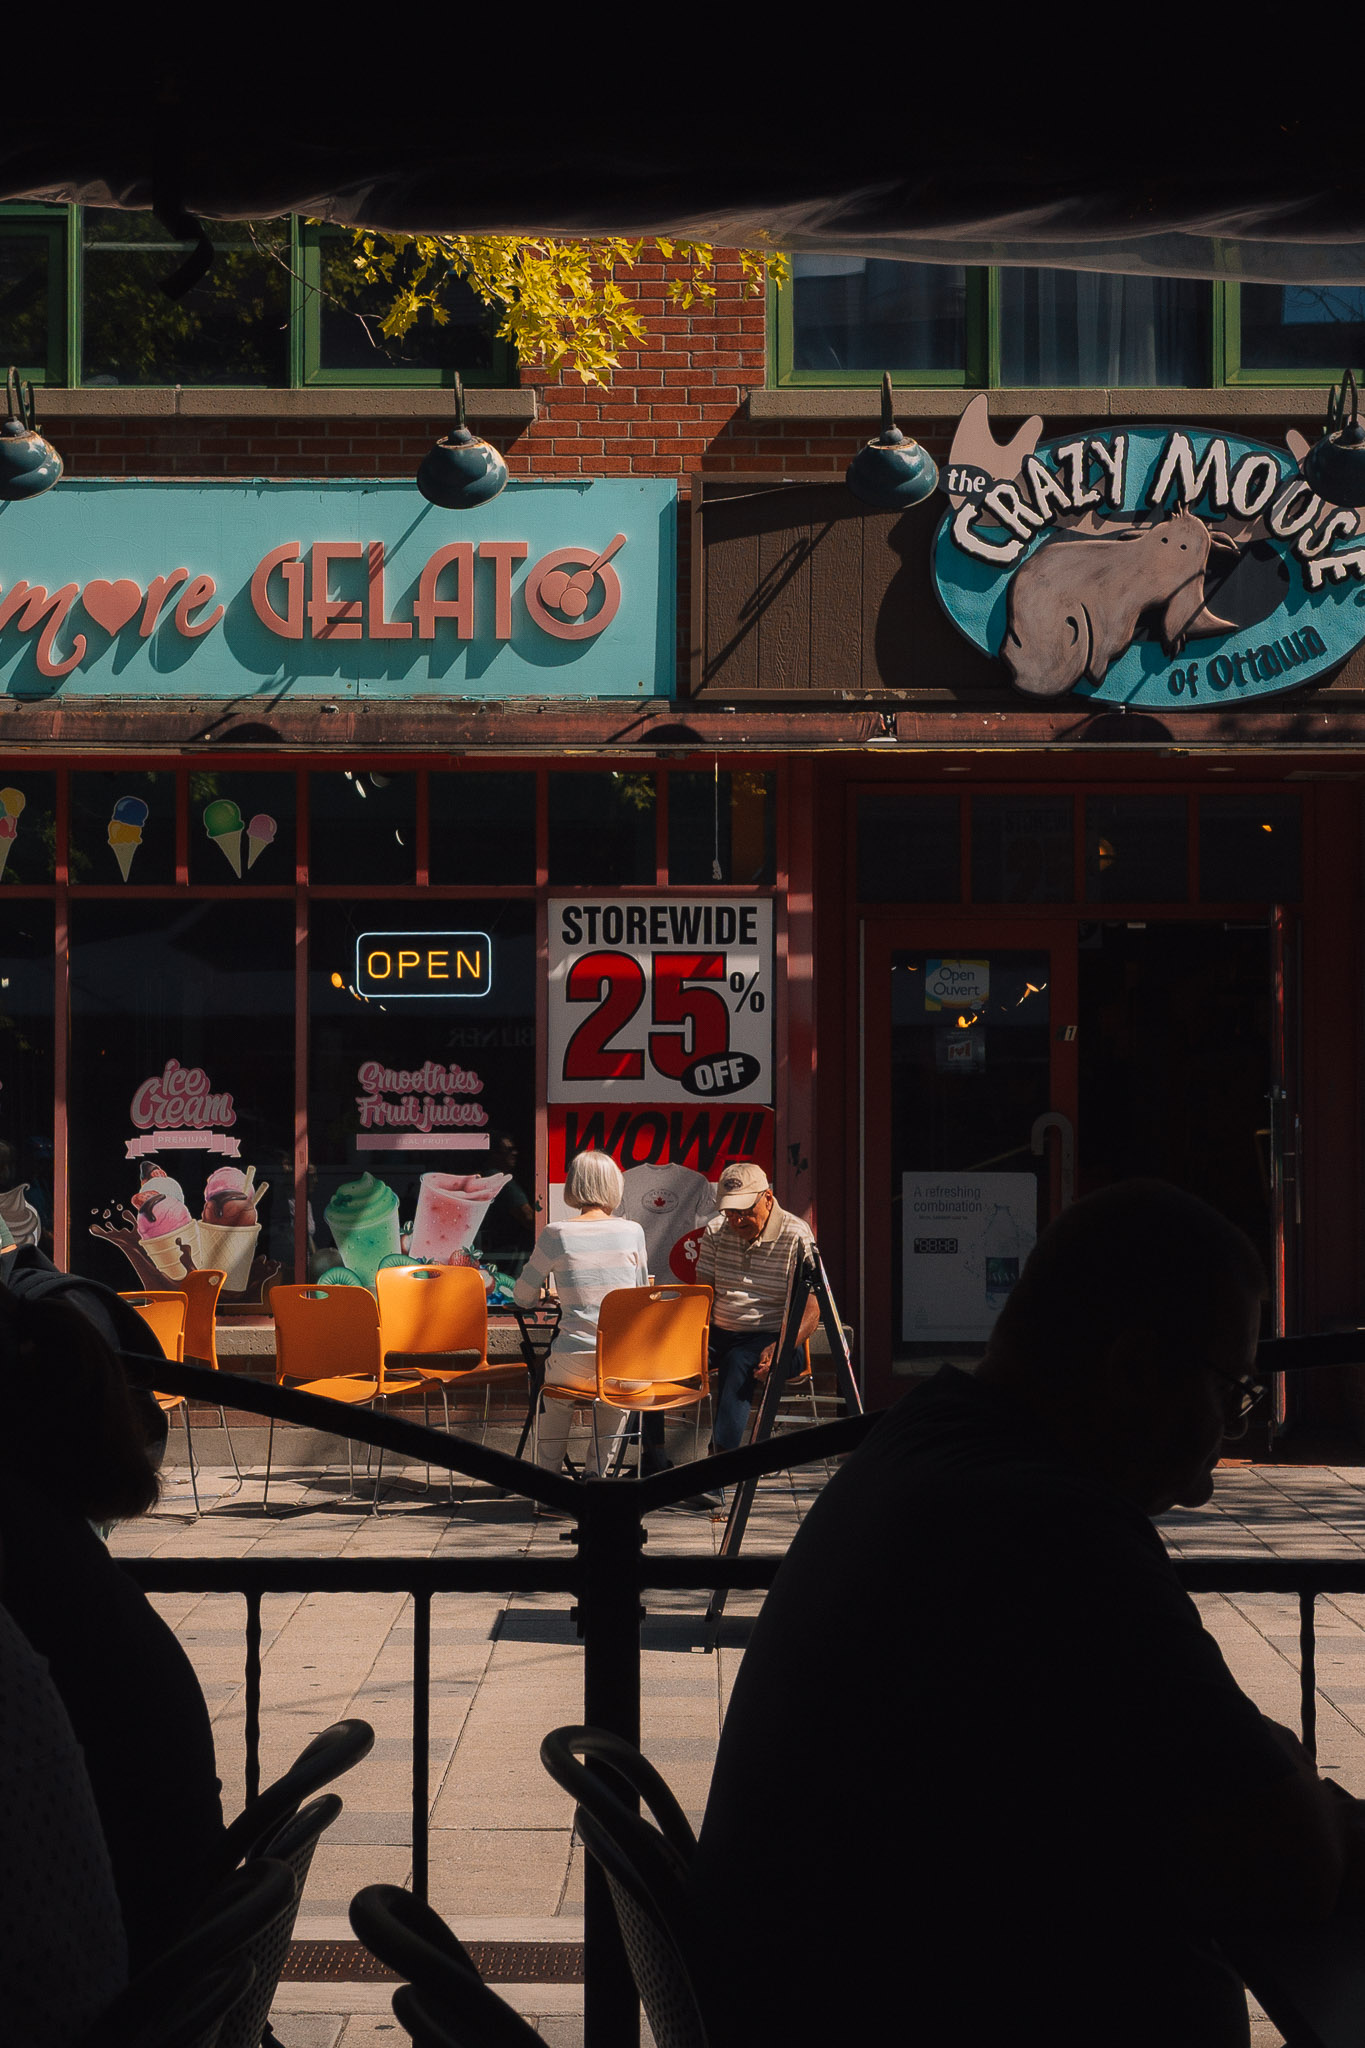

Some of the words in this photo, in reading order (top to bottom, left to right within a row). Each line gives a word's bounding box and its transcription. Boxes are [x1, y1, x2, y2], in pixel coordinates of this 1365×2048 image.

[947, 468, 987, 493] the
[953, 434, 1128, 565] CRAZY
[1151, 433, 1365, 588] MOOSE
[250, 532, 627, 641] GELATO
[1167, 663, 1198, 697] of
[1206, 625, 1328, 690] Ottawa
[562, 905, 758, 945] STOREWIDE
[367, 950, 482, 979] OPEN
[939, 967, 975, 984] Open
[933, 982, 980, 995] Ouvert
[562, 949, 765, 1081] 25%
[694, 1057, 745, 1091] OFF
[357, 1061, 483, 1095] Smoothies
[131, 1079, 236, 1128] Cream
[356, 1097, 418, 1128] Fruit
[413, 1097, 488, 1132] juices
[157, 1135, 208, 1144] PREMIUM
[914, 1187, 922, 1197] A
[925, 1186, 981, 1200] refreshing
[914, 1200, 982, 1212] combination
